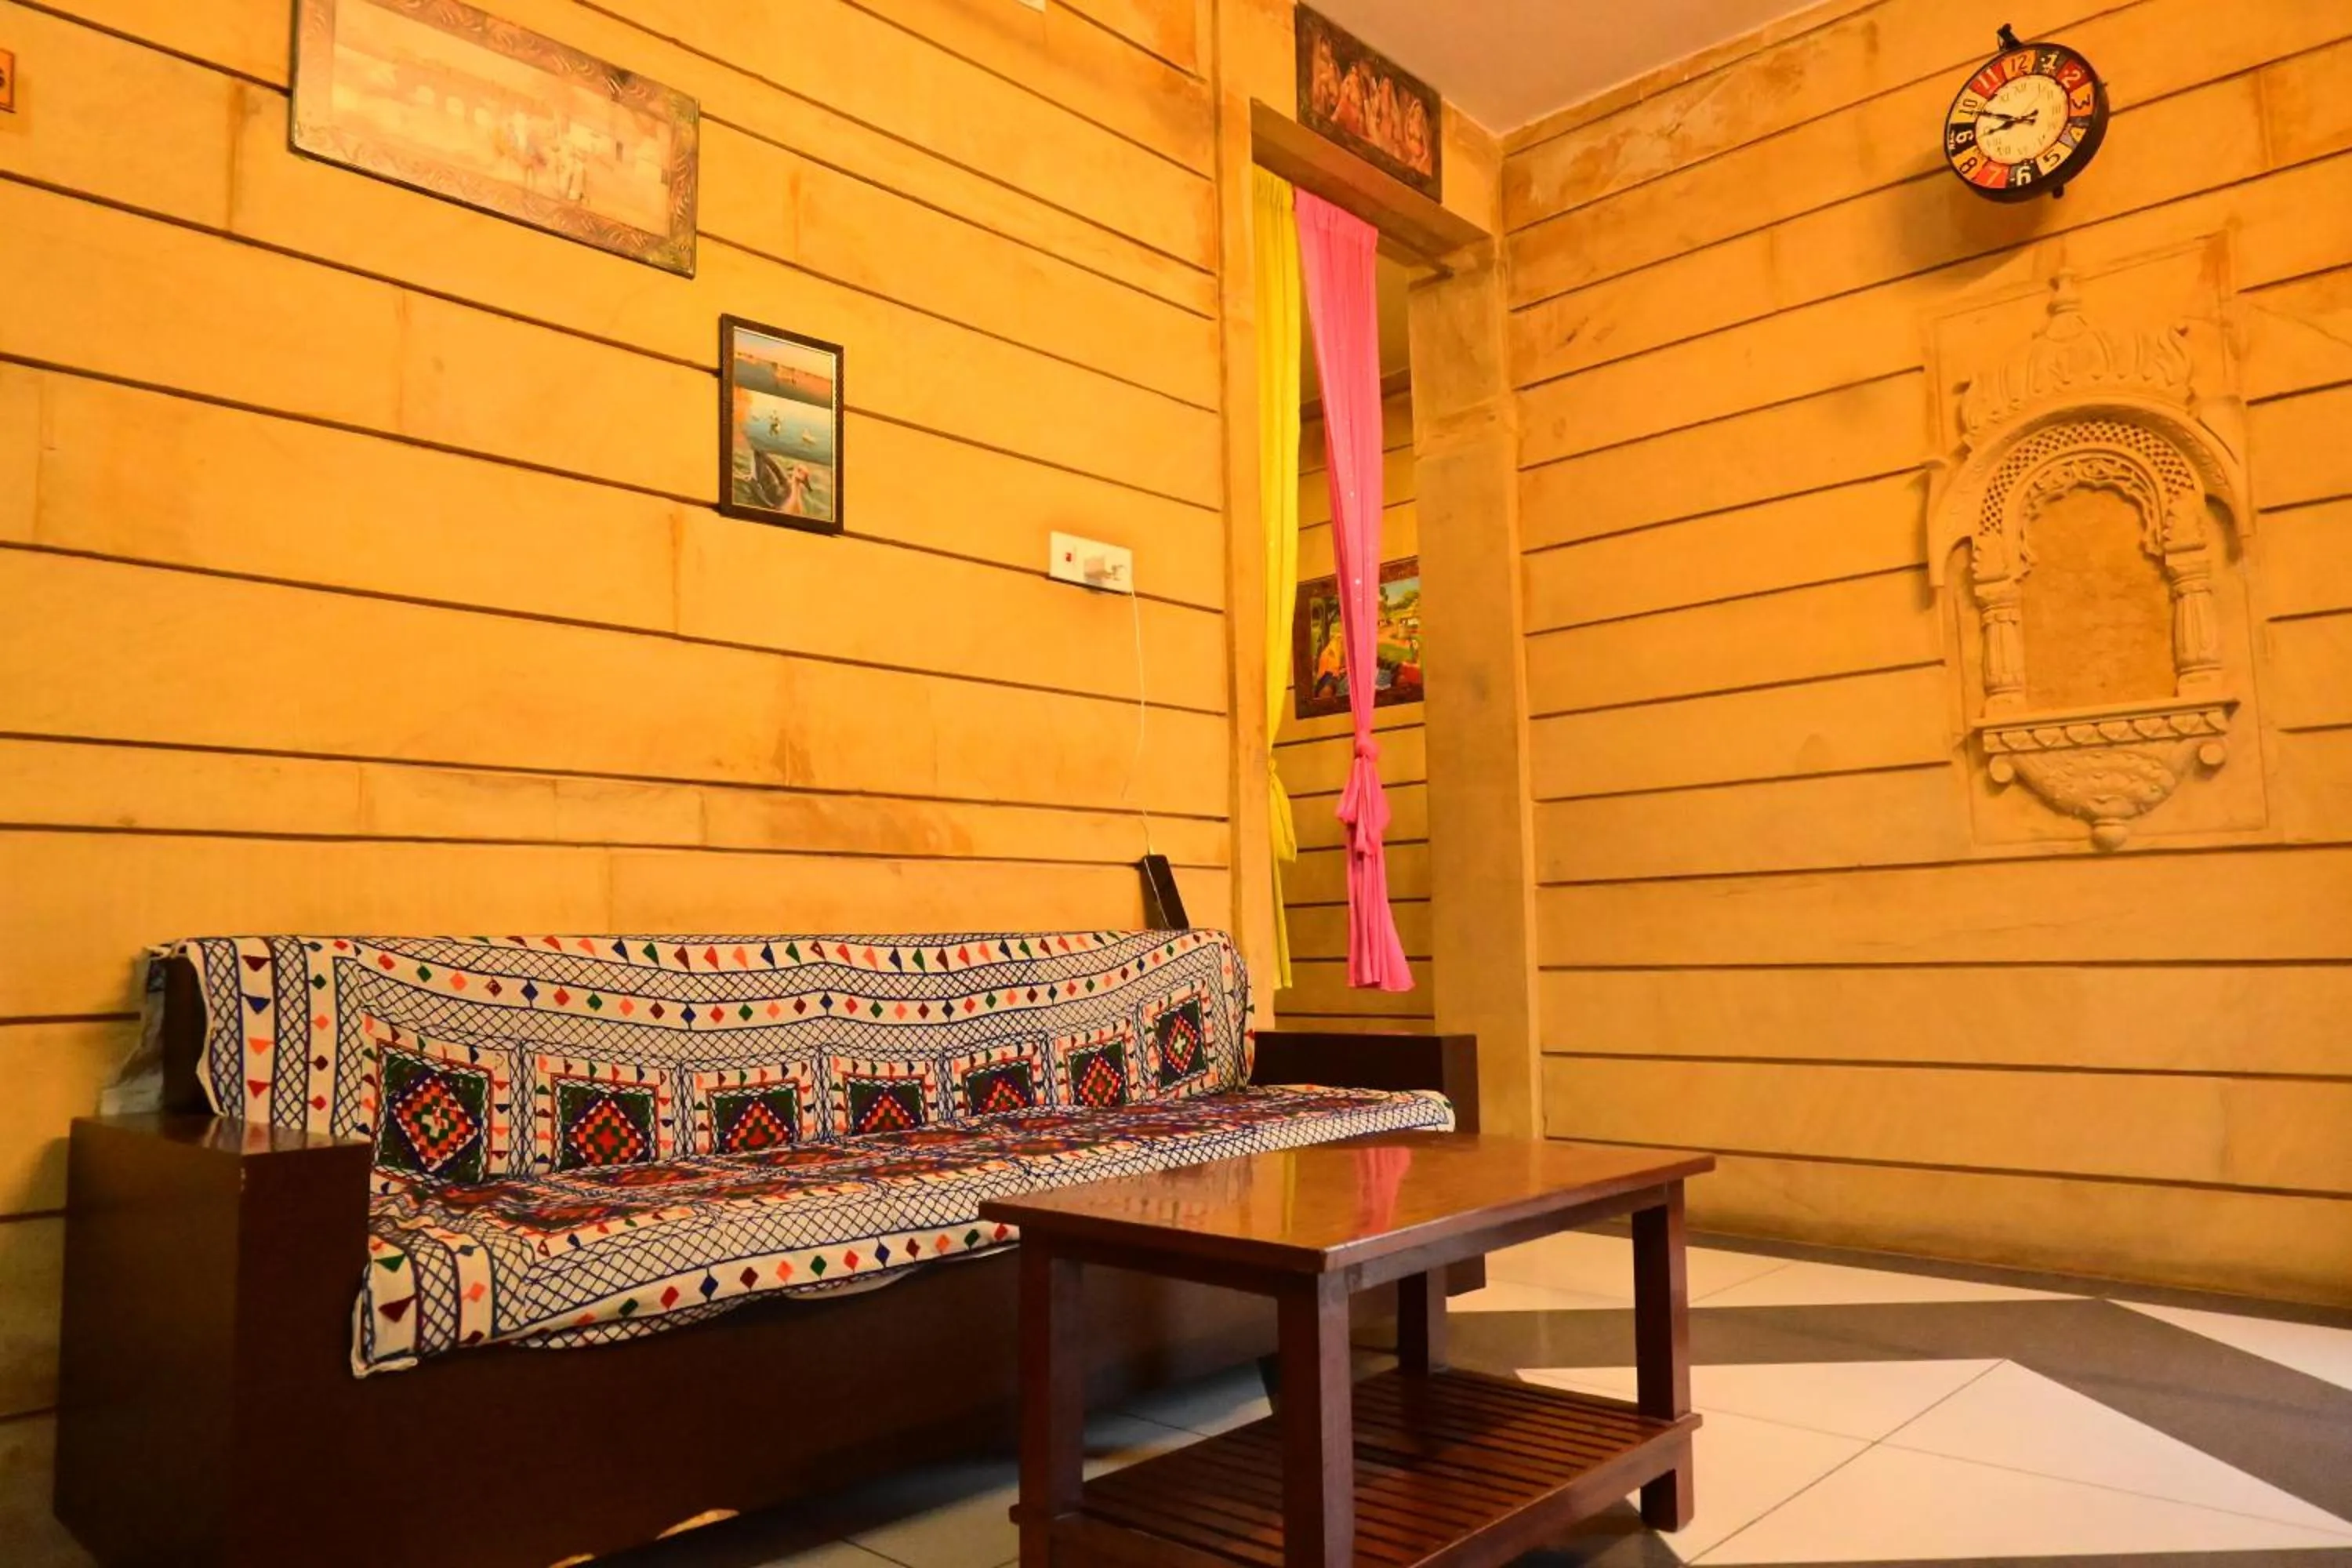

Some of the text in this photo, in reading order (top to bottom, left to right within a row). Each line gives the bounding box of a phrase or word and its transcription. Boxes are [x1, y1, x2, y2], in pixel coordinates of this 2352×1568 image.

[2009, 54, 2027, 71] 12
[1978, 69, 1998, 89] 11
[2061, 70, 2081, 88] 2
[2071, 93, 2091, 110] 3
[1956, 129, 1974, 143] 9
[1959, 157, 1978, 173] 8
[2042, 149, 2061, 167] 5
[1986, 166, 2003, 184] 7
